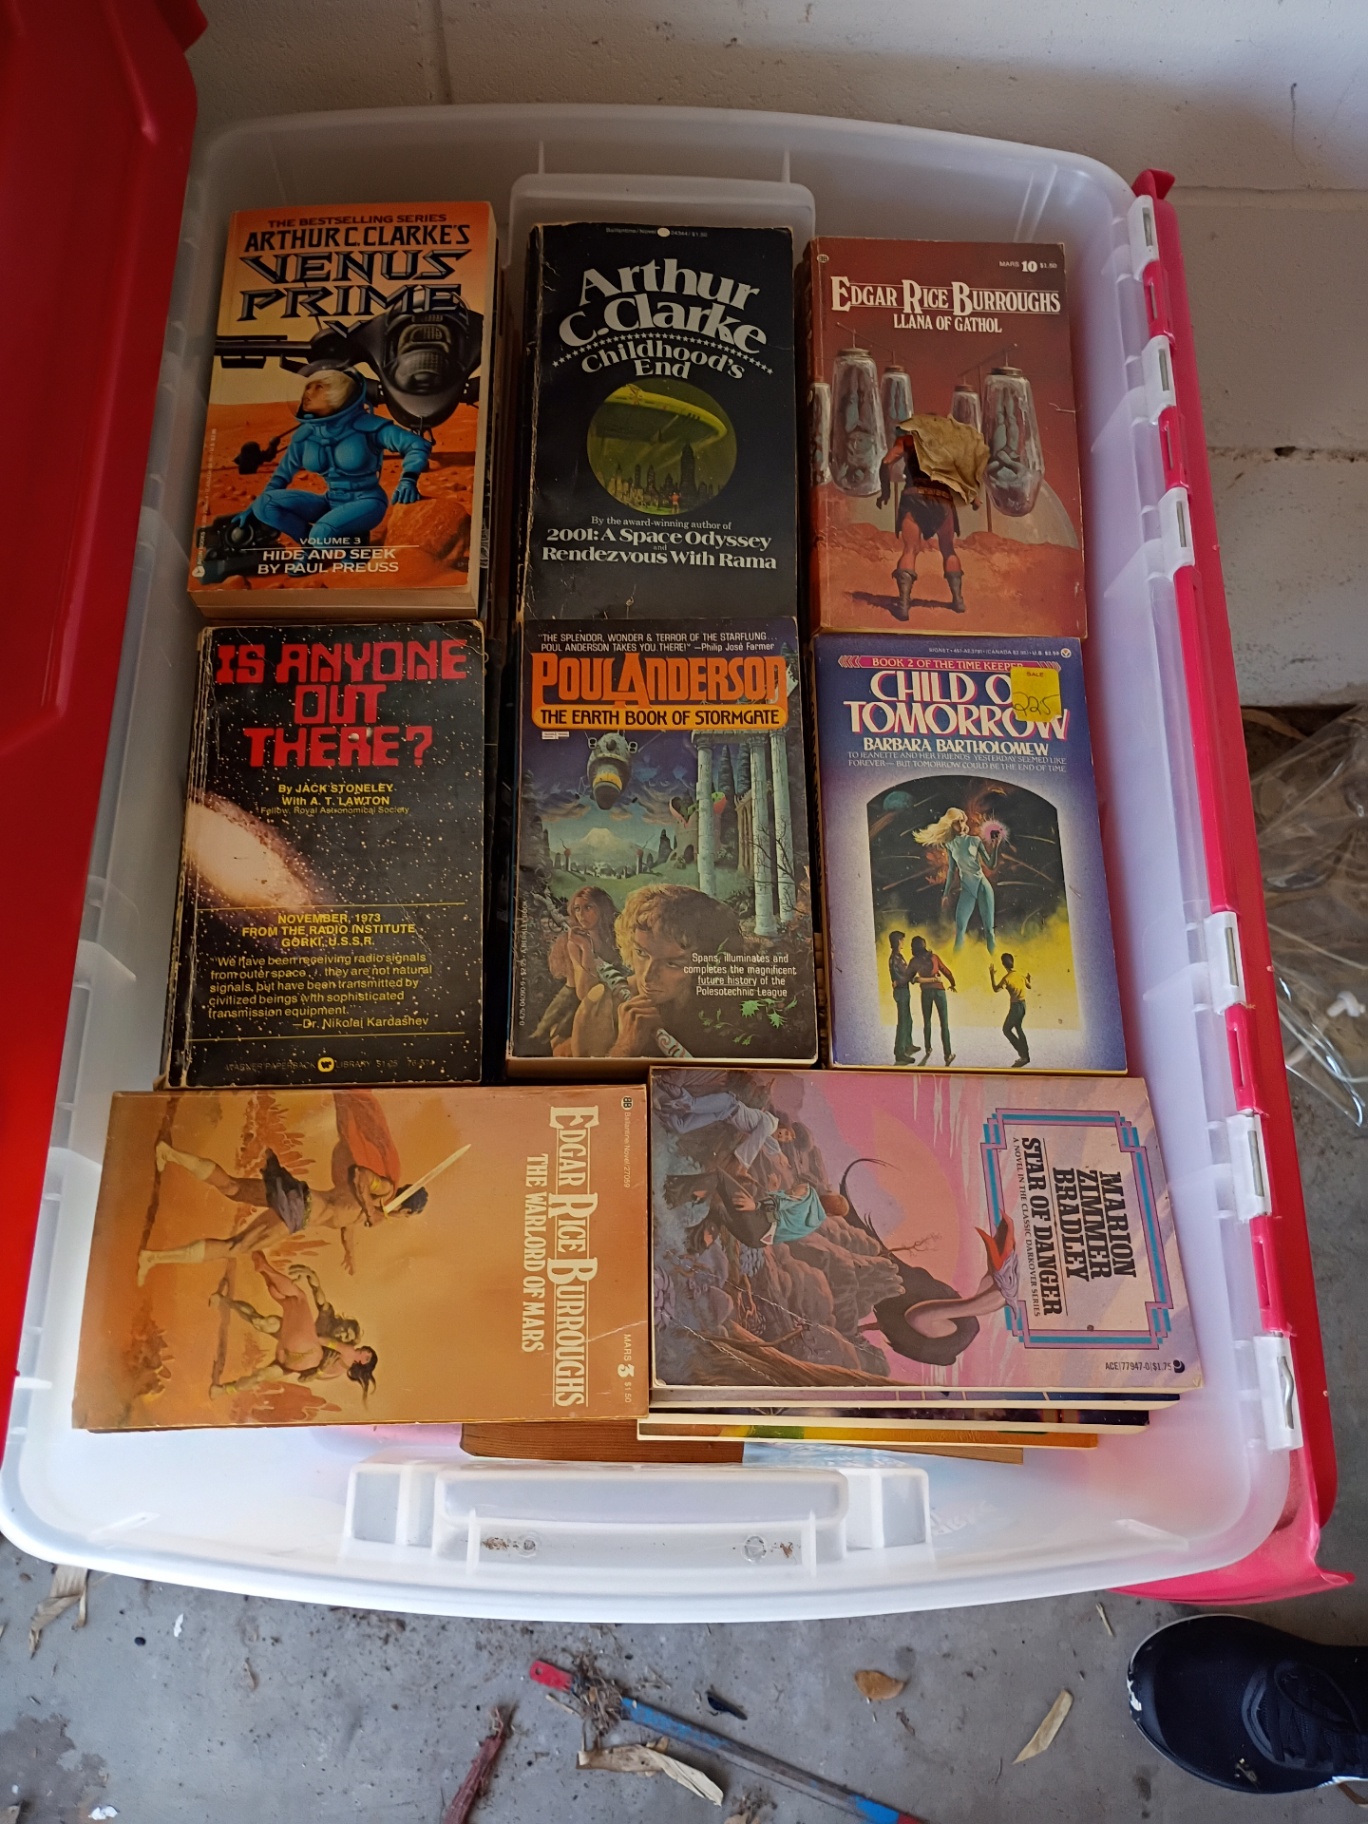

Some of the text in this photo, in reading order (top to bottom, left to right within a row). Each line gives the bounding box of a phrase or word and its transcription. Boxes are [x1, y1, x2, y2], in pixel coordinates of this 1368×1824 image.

[269, 214, 447, 228] THE BESTSELLING SERIES
[244, 224, 470, 252] ARTHUR C. CLARKE'S
[239, 249, 472, 285] VENUS
[1021, 260, 1037, 272] 10
[578, 258, 760, 310] Arthur
[236, 284, 462, 322] PRIME
[830, 276, 1061, 316] EDGAR RICE BURROUGHS
[604, 293, 767, 354] Clarke
[893, 314, 1002, 333] LLANA OF GATHOL
[581, 340, 745, 379] Childhood's
[634, 359, 690, 379] End
[591, 516, 732, 530] By the award-winning author of
[300, 537, 361, 546] VOLUME 3
[547, 528, 772, 551] 2001: A Space Odyssey
[263, 548, 396, 561] HIDE AND SEEK
[542, 547, 777, 569] Rendezvous With Rama
[257, 561, 399, 575] BY PAUL PREUSS
[607, 632, 717, 642] WONDER TERROR OF THE
[541, 642, 563, 651] POUL
[565, 642, 610, 651] ANDERSON
[613, 642, 637, 651] TAKES
[639, 642, 656, 651] YOU
[746, 642, 775, 651] Farmer
[215, 640, 467, 684] IS ANYONE
[872, 657, 905, 667] BOOK
[907, 659, 914, 668] 2
[917, 659, 932, 668] OF
[932, 659, 954, 669] THE
[956, 660, 982, 670] TIME
[870, 670, 977, 702] CHILD
[294, 684, 387, 724] OUT
[541, 709, 780, 725] THE EARTH BOOK OF STORMGATE
[243, 725, 433, 767] THERE?
[864, 738, 1049, 757] BARBARA BARTHOLOMEW
[859, 752, 899, 760] JEANETTE
[973, 754, 1016, 763] YESTERDAY
[1017, 756, 1049, 764] SEEMED
[1050, 757, 1067, 765] LIKE
[896, 760, 1067, 773] BUT TOMORROW COULD END TIME
[278, 783, 394, 794] By JACK STONELEY
[281, 796, 390, 806] With LAWTON
[294, 806, 410, 816] Royal Society
[355, 914, 381, 923] 1973
[242, 924, 416, 937] FROM THE RADIO INSTITUTE
[238, 953, 426, 967] have been receiving radio signals
[724, 953, 789, 963] illuminates and
[210, 965, 433, 981] from outer space they are not natural
[683, 965, 744, 975] completes the
[277, 977, 420, 990] have been transmitted by
[697, 975, 786, 987] future history of the
[209, 991, 405, 1006] civilized beings with sophisticated
[696, 986, 788, 998] Polesotechnic League
[208, 1007, 283, 1019] transmission
[366, 1015, 429, 1027] Kardashev
[1014, 1144, 1041, 1317] NOVEL THE CLASSIC DARKOVER SERIES
[1021, 1137, 1063, 1316] STAR OF DANGER
[1052, 1167, 1089, 1282] BRADLEY
[1075, 1169, 1113, 1280] ZIMMER
[1099, 1171, 1137, 1278] MARION
[521, 1153, 549, 1353] THE WARLORD OF MARS
[547, 1105, 599, 1408] EDGAR RICE BURROUGHS
[617, 1333, 635, 1378] MARS 3
